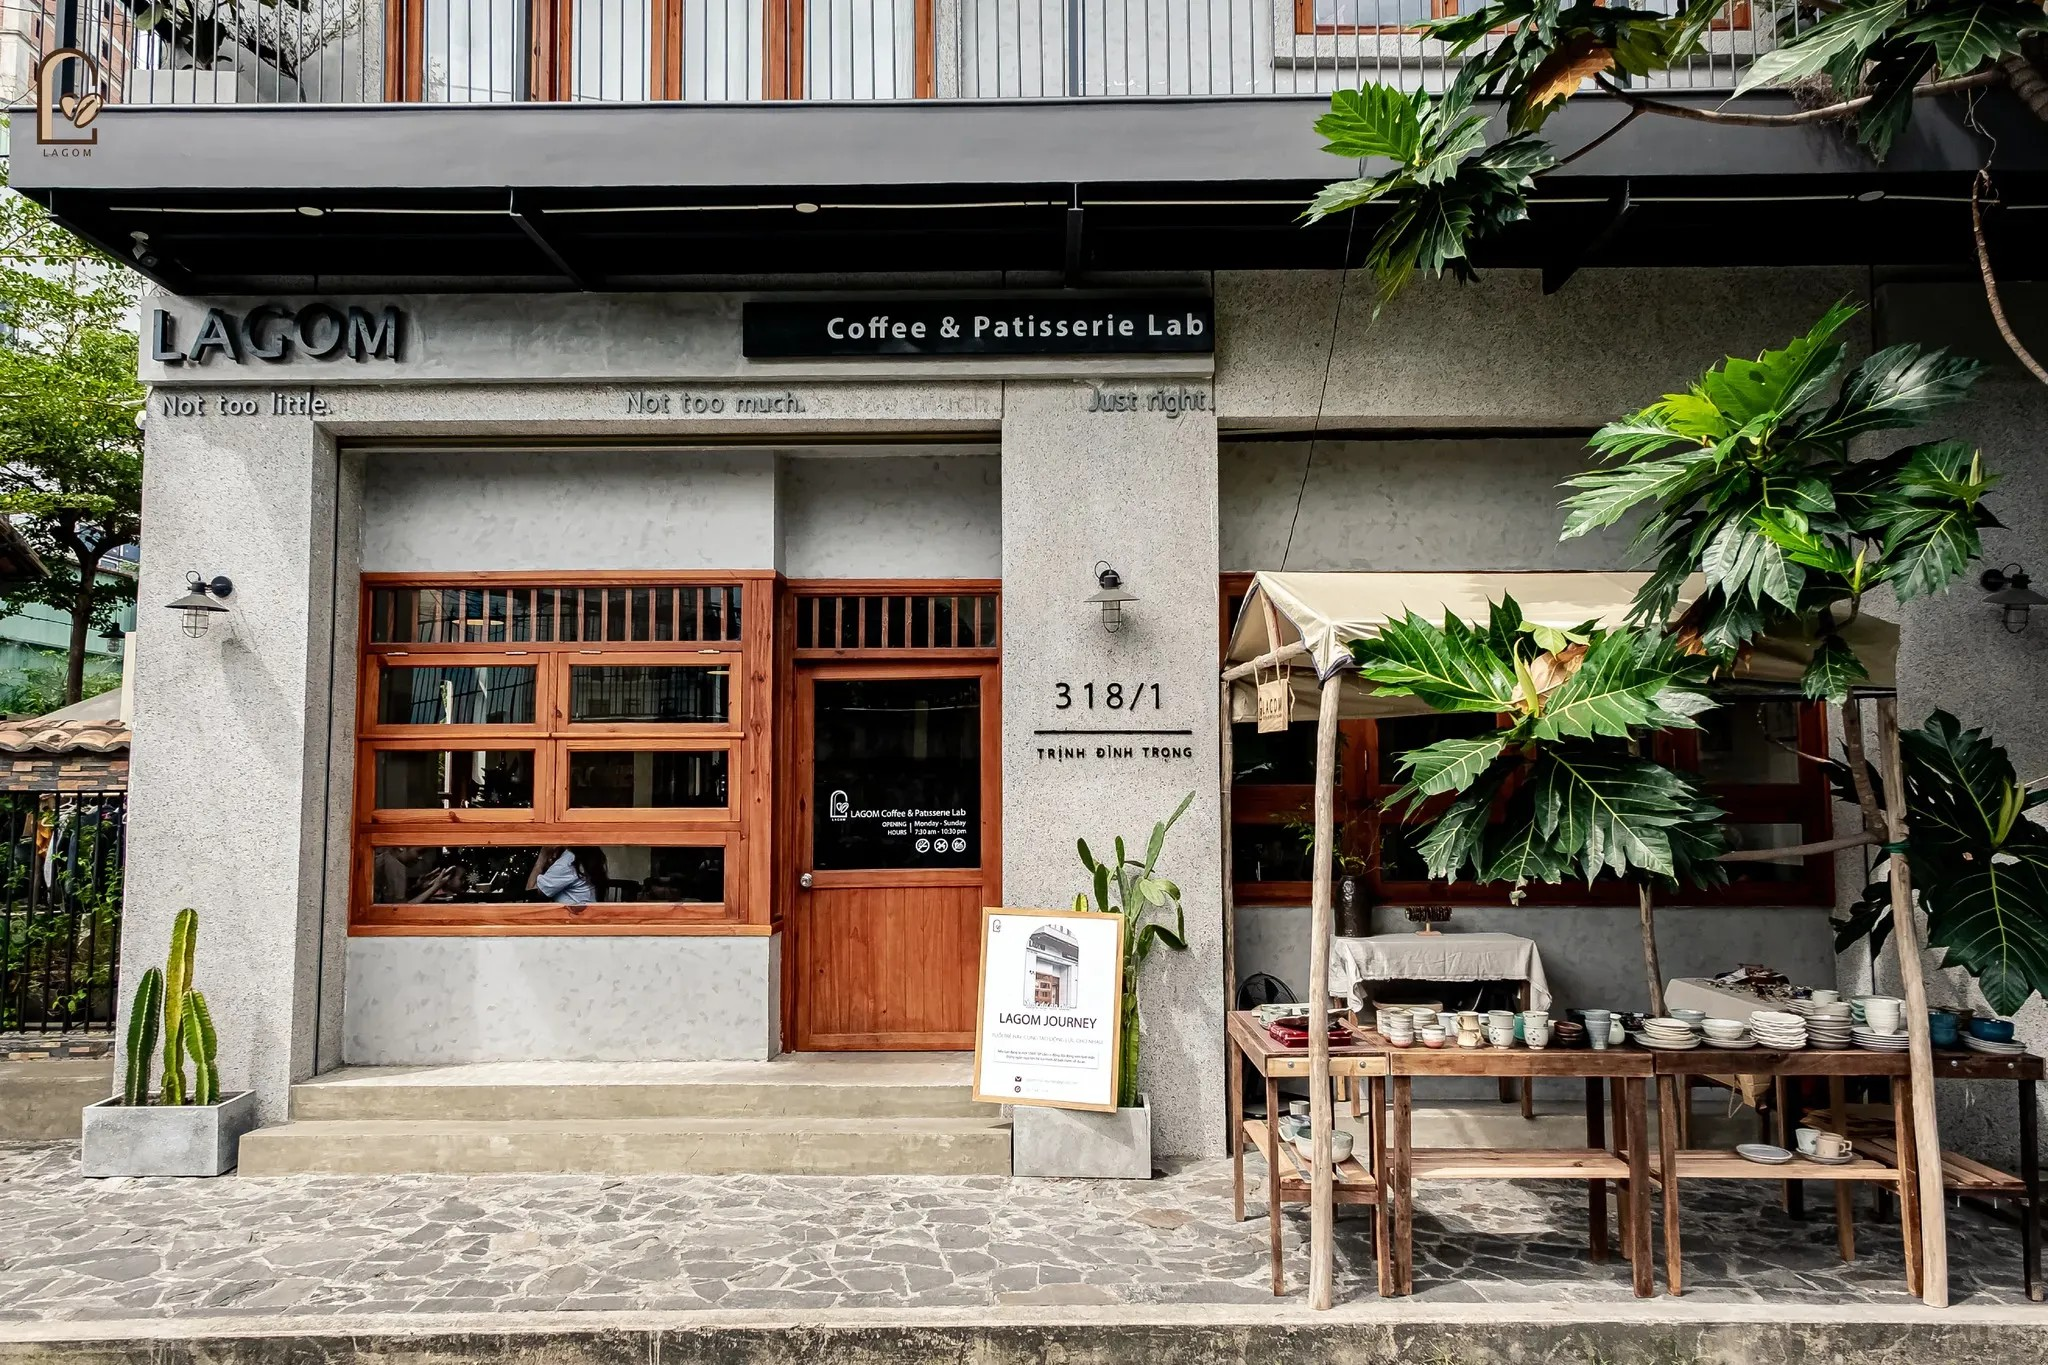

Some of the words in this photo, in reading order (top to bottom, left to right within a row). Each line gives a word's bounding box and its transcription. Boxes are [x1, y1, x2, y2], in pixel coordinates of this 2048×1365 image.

[152, 303, 401, 364] LAGOM
[827, 316, 927, 339] Coffee
[940, 316, 960, 339] &
[974, 314, 1135, 338] Patisserie
[1148, 313, 1204, 336] Lab
[162, 395, 205, 416] Not
[219, 395, 258, 416] too
[270, 391, 333, 416] little.
[626, 391, 670, 413] Not
[681, 392, 724, 413] too
[736, 391, 806, 413] much.
[1087, 386, 1139, 413] Just
[1146, 385, 1215, 418] right.
[1055, 682, 1160, 711] 318/1
[1037, 745, 1085, 762] TRỊNH
[1096, 745, 1133, 759] ĐÌNH
[1142, 747, 1193, 762] TRỌNG
[851, 810, 880, 818] LAGOM
[881, 809, 906, 818] Coffee
[907, 809, 914, 817] &
[915, 809, 950, 817] Patisserie
[952, 808, 967, 816] Lab
[914, 820, 939, 828] Monday
[999, 1013, 1041, 1025] LAGOM
[1043, 1015, 1097, 1029] JOURNEY
